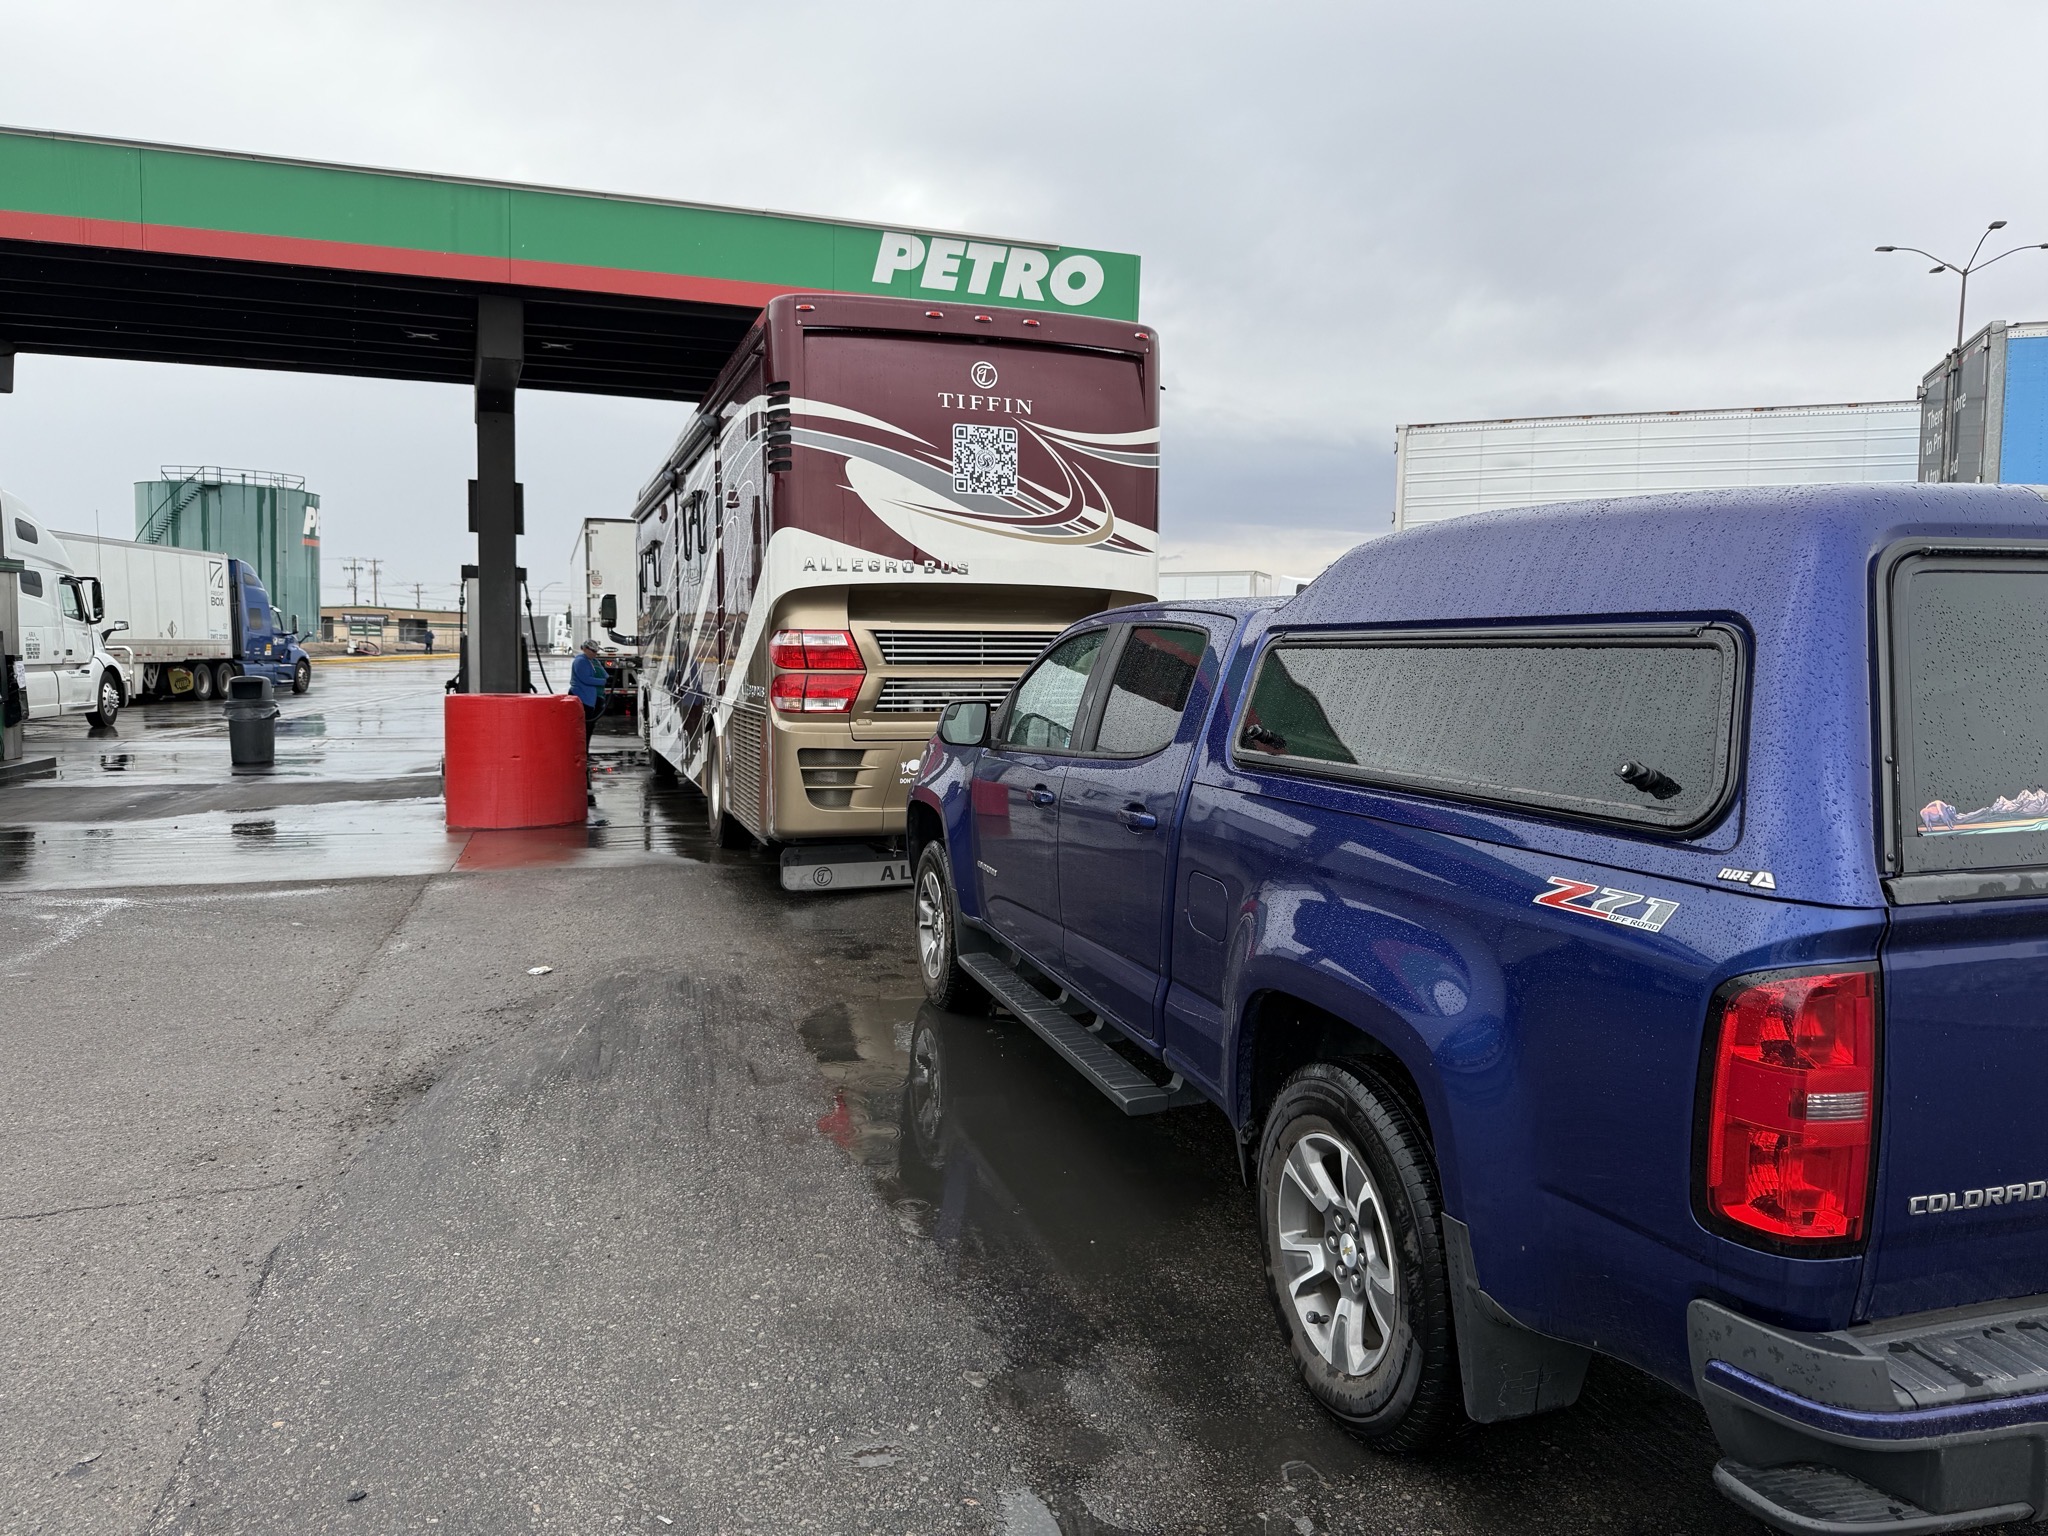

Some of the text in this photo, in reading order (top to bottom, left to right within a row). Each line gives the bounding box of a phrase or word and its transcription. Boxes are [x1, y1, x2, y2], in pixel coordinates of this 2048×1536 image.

[872, 231, 1105, 306] PETRO
[937, 392, 1033, 415] TIFFIN
[803, 556, 970, 576] ALLEGRO BUS
[210, 597, 224, 607] BOX
[1719, 867, 1753, 882] ARE
[1532, 876, 1680, 928] Z71
[1608, 914, 1660, 932] OFF ROAD
[1908, 1180, 2048, 1216] COLORAD
